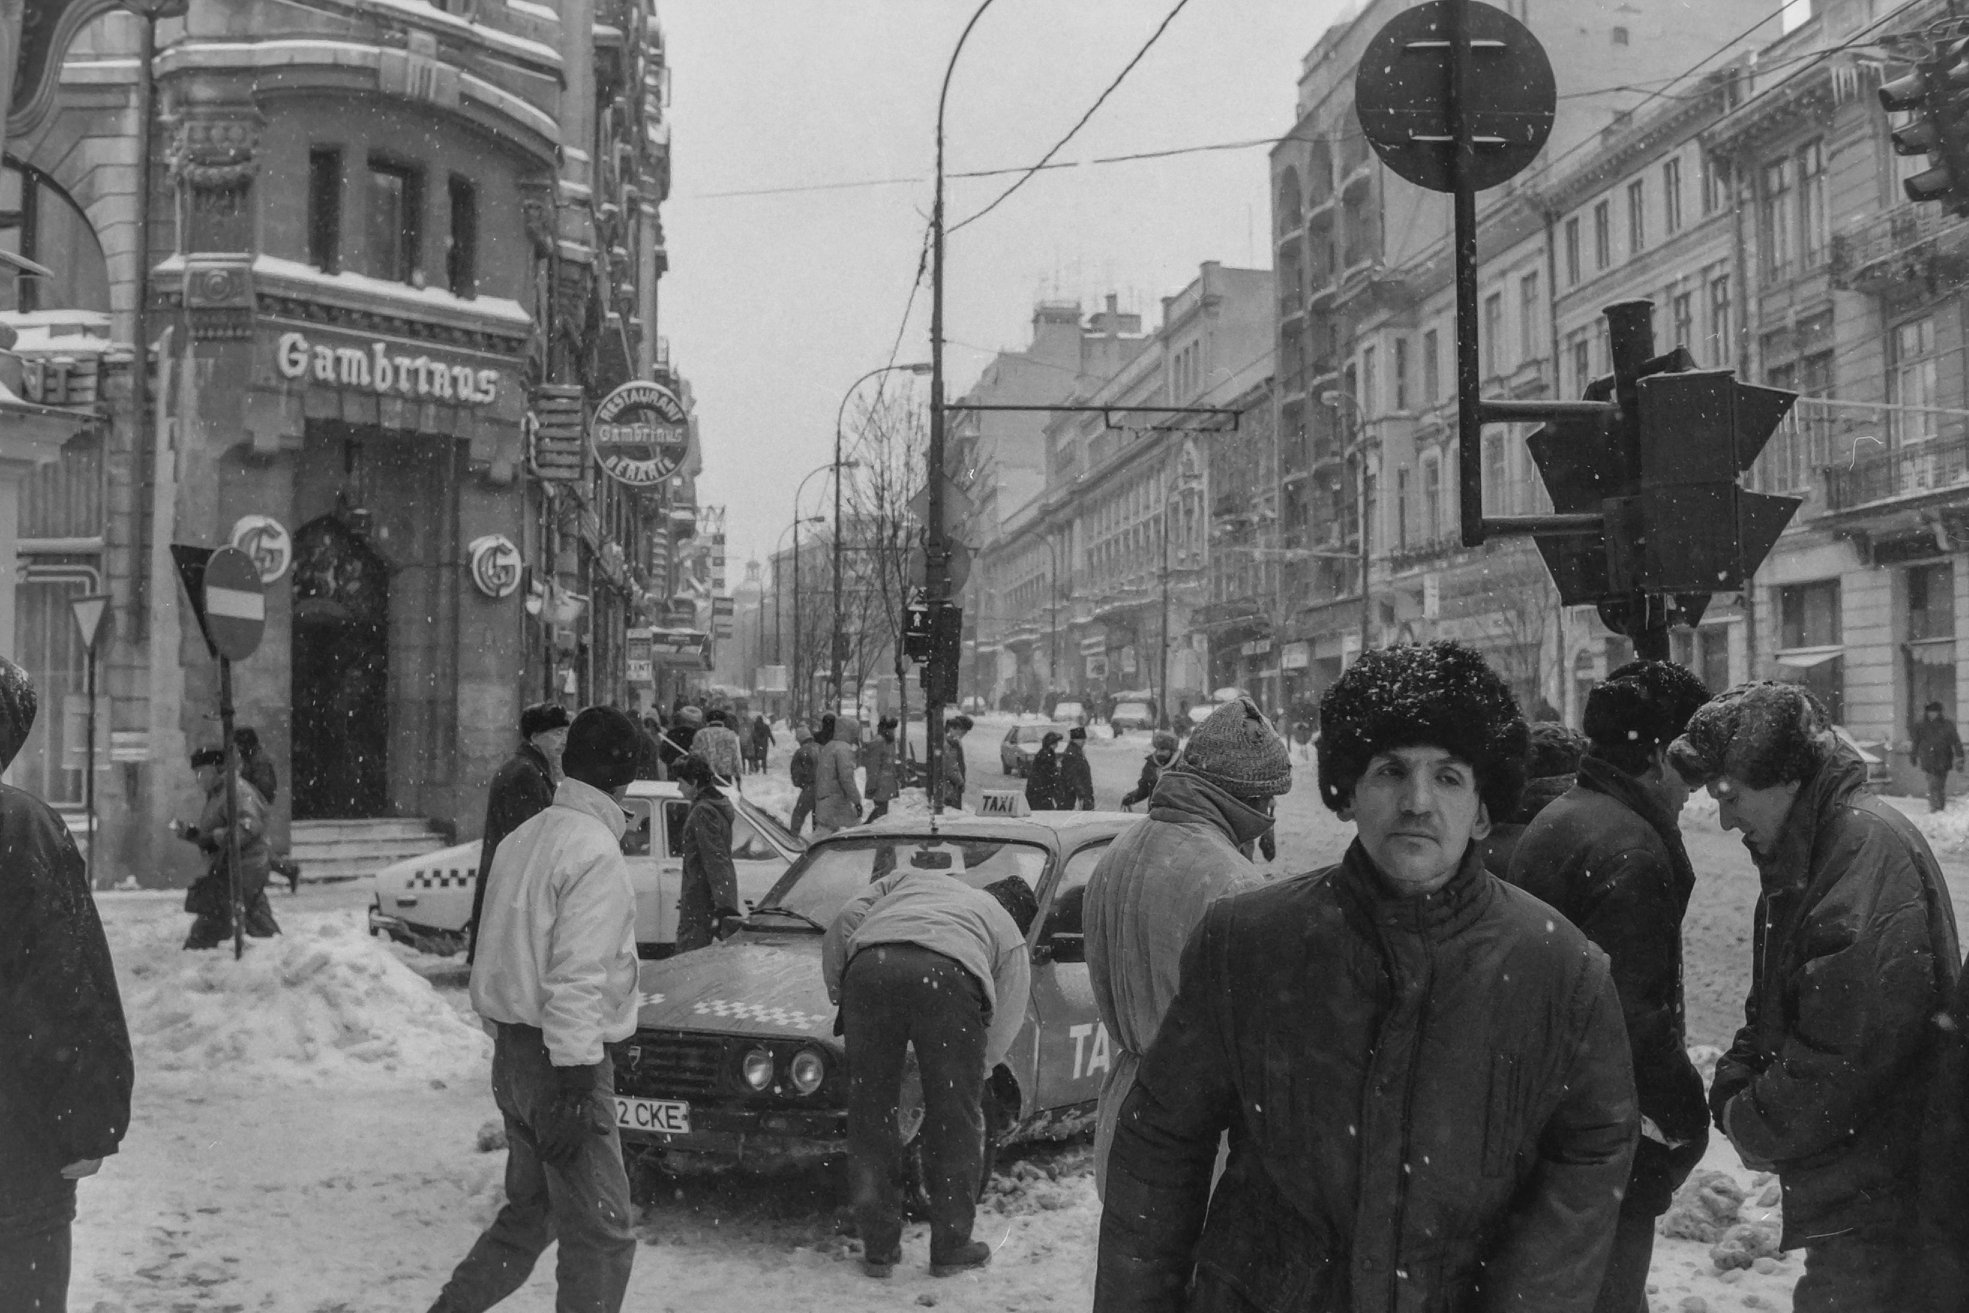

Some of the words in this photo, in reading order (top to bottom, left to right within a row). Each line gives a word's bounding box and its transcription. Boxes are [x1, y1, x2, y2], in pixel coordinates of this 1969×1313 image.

[278, 332, 500, 404] Gambrinus
[599, 387, 684, 422] RESTAURANT
[599, 422, 683, 443] Gambrinus
[982, 795, 1015, 813] TAXI
[1069, 1021, 1110, 1080] TA
[635, 1102, 683, 1130] CKE
